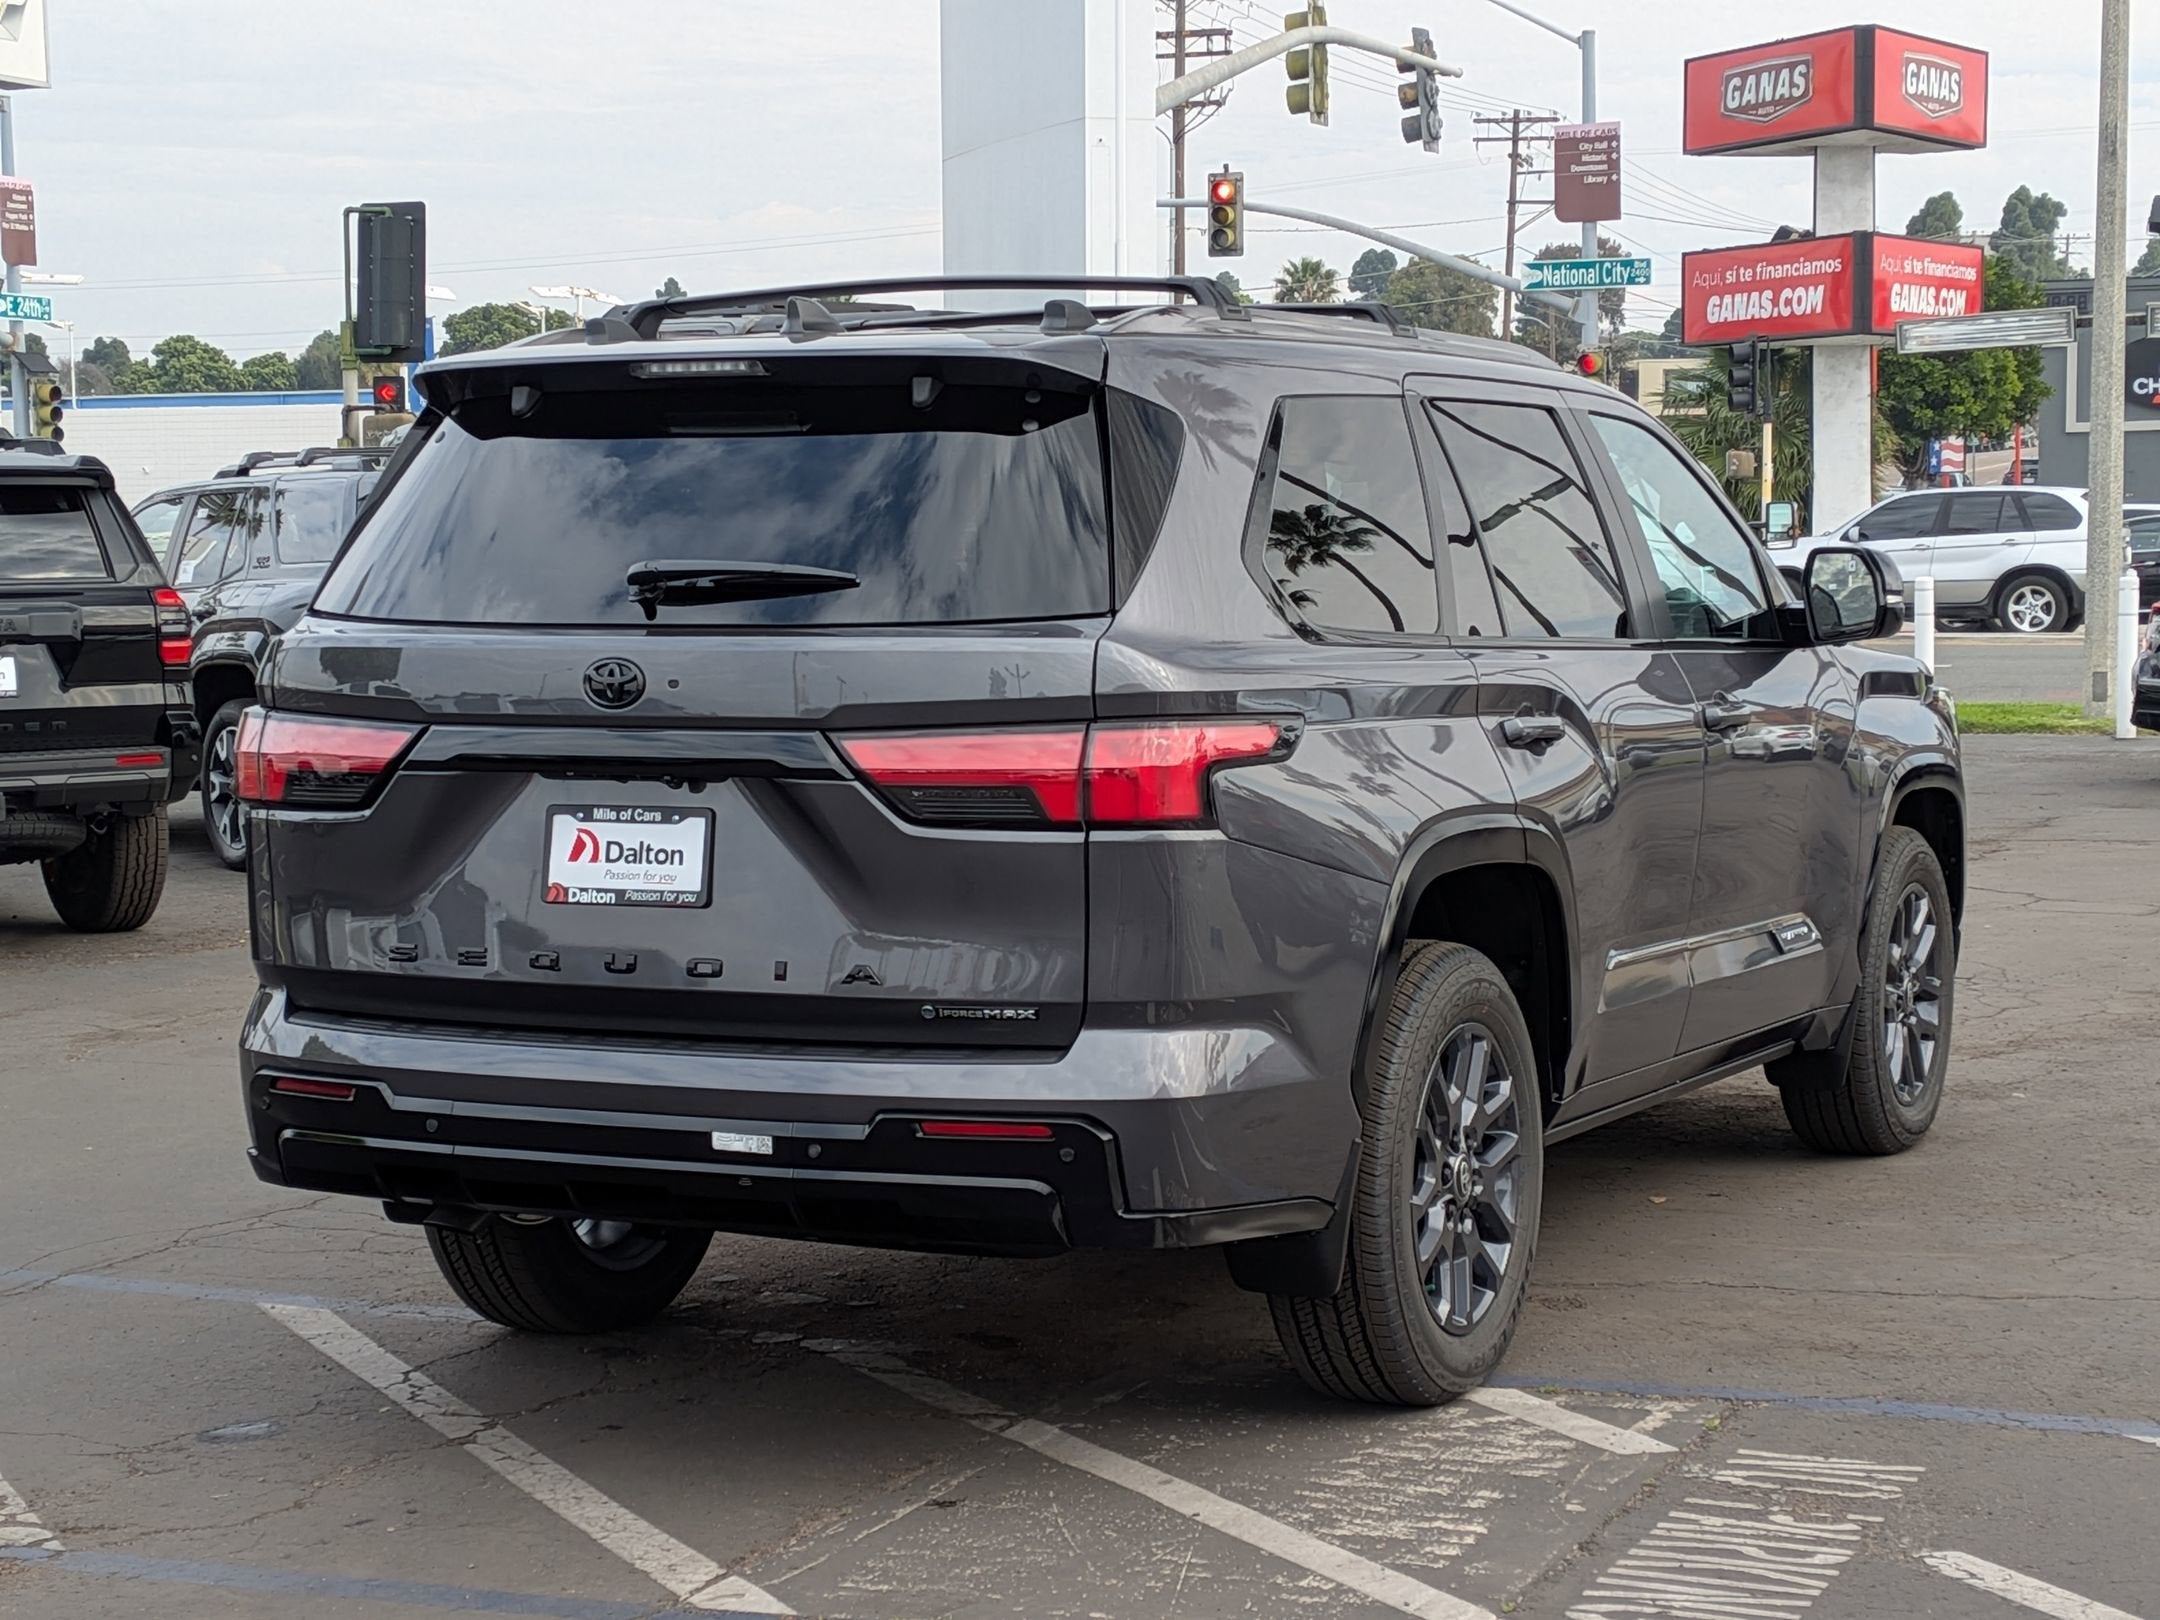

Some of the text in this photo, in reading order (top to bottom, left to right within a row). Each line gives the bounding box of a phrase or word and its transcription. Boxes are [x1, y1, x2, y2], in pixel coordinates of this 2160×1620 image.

[1726, 64, 1808, 109] GANAS
[1906, 62, 1960, 103] GANAS
[1757, 106, 1775, 115] AUTO
[1578, 142, 1593, 151] City
[1583, 175, 1608, 184] Library
[1543, 261, 1632, 287] National City
[1633, 260, 1647, 268] Blvd
[1725, 265, 1738, 284] sí
[1739, 267, 1753, 282] te
[1756, 257, 1842, 281] financiamos
[1913, 258, 1923, 275] te
[1924, 256, 1977, 281] financiamos
[6, 296, 17, 316] E
[17, 297, 42, 318] 24th
[1707, 285, 1825, 324] GANAS.COM
[1890, 282, 1967, 316] GANAS.COM
[593, 808, 662, 822] Mile of Cars
[605, 840, 684, 866] Dalton
[604, 870, 677, 884] Passion for you
[568, 888, 697, 904] Dalton Passion for you
[388, 943, 885, 986] SEQUOIA
